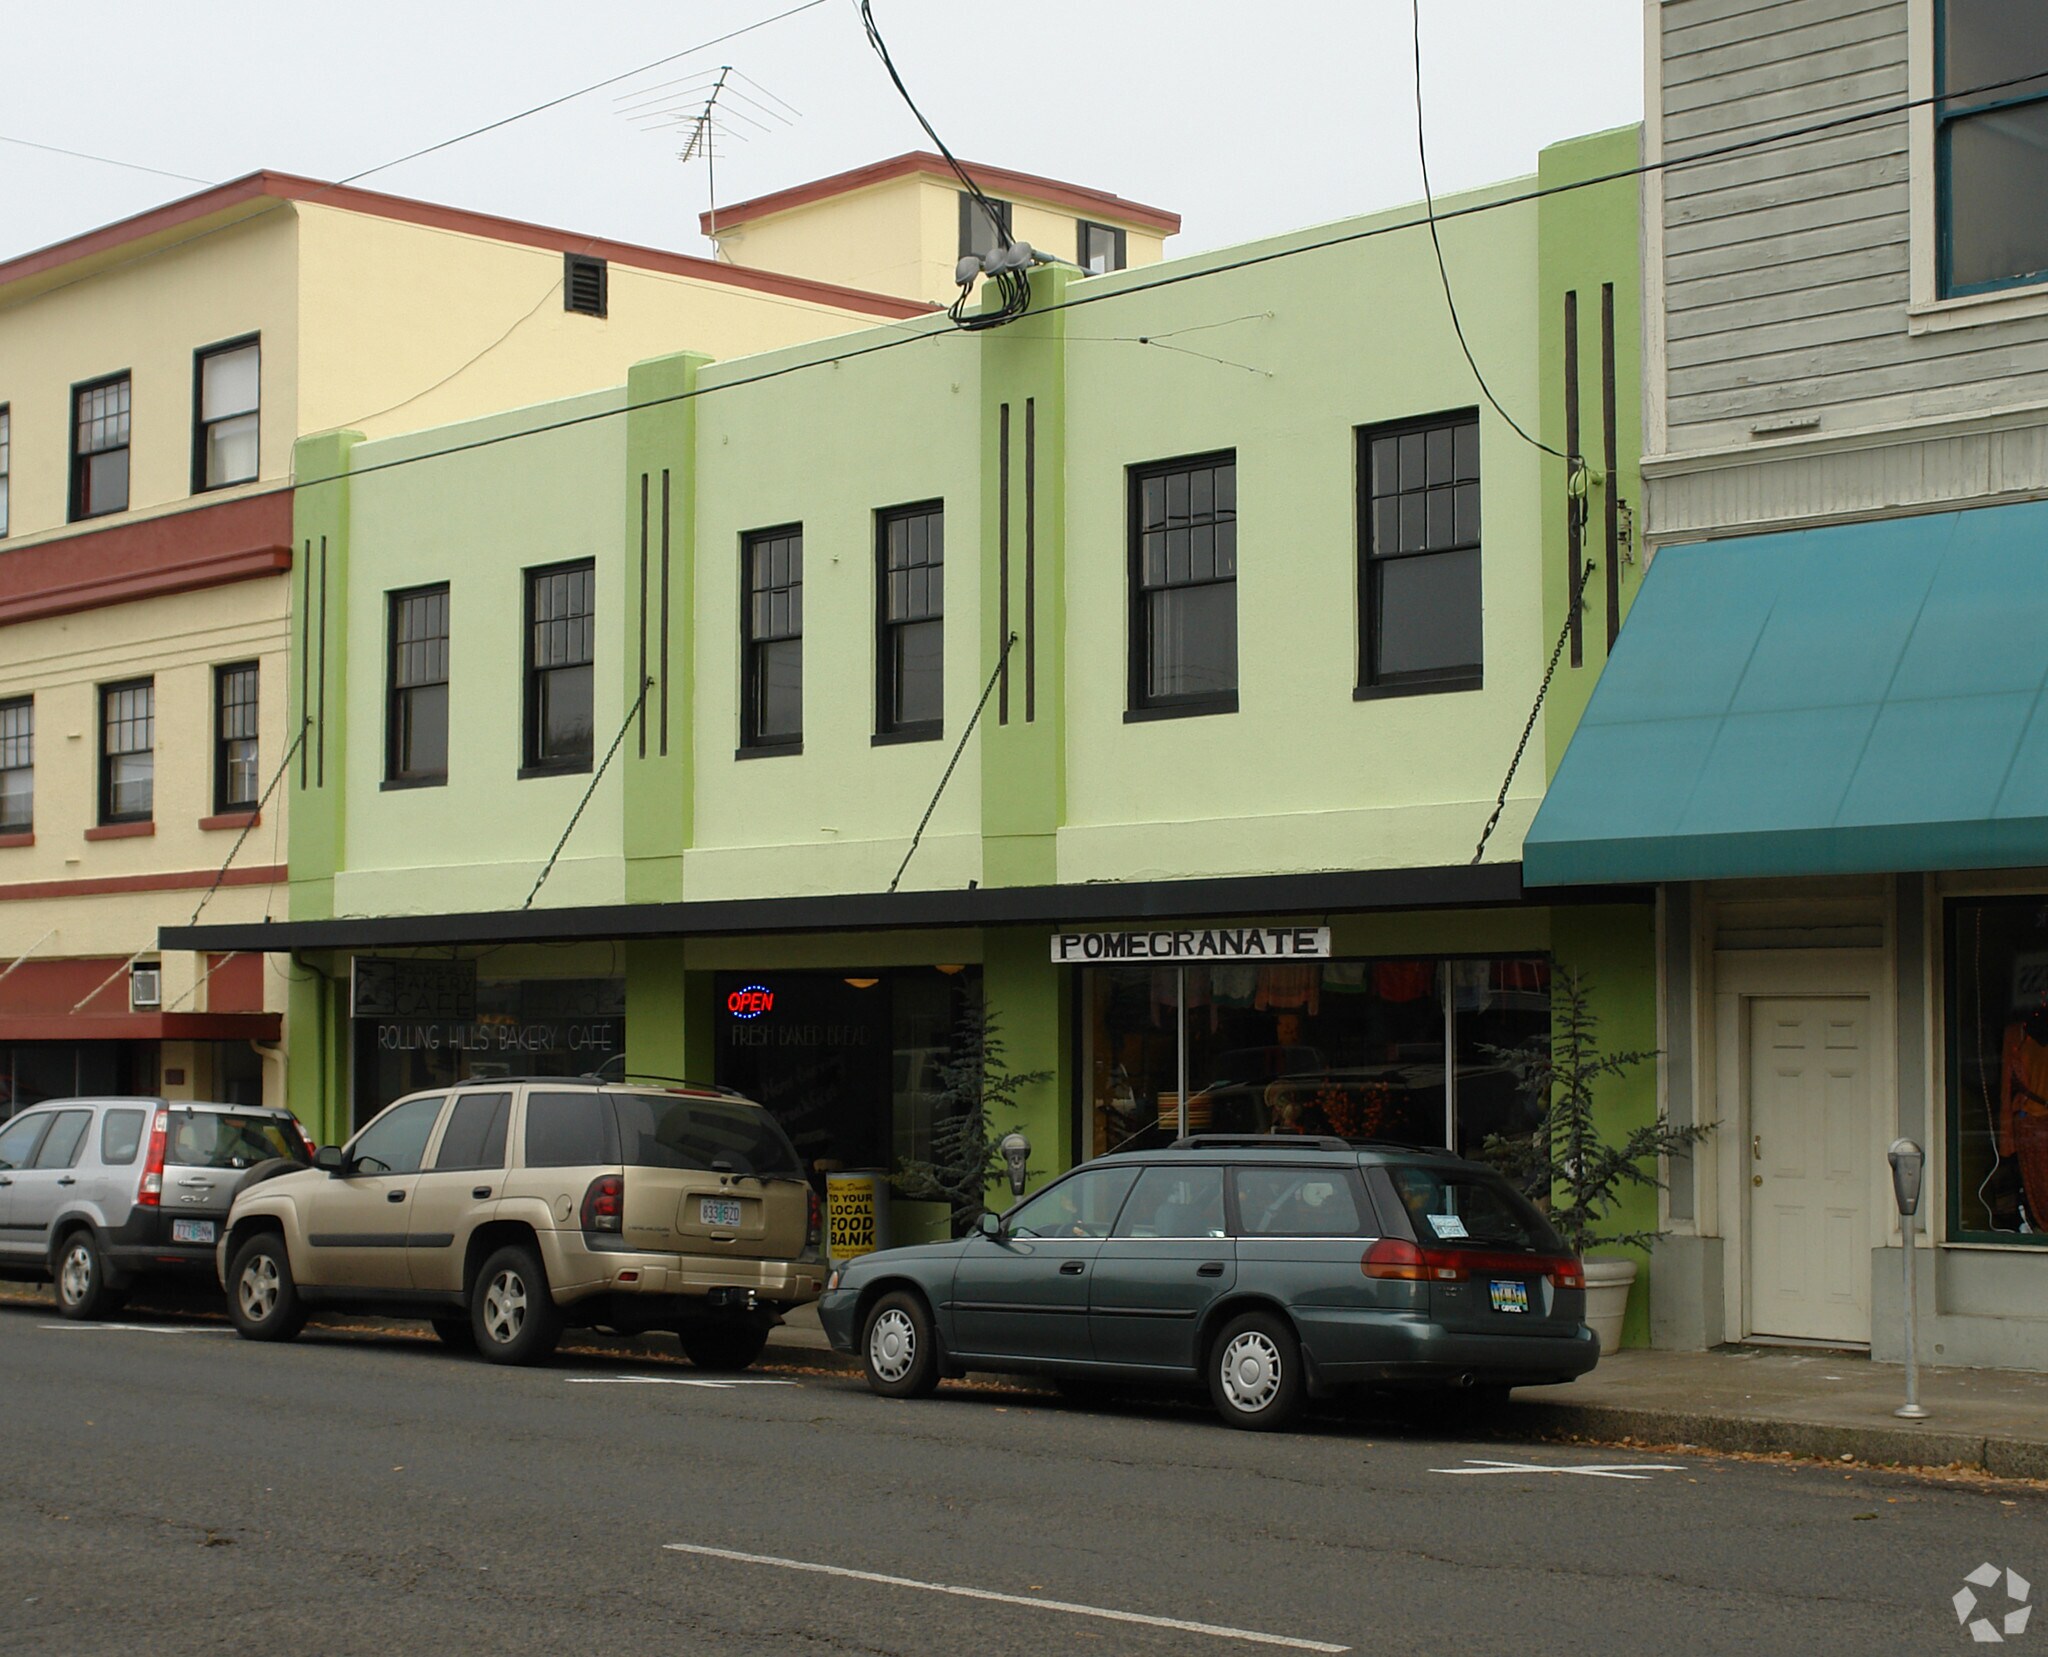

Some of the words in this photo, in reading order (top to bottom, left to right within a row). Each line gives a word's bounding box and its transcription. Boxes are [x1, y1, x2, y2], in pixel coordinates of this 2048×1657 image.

[1059, 928, 1319, 959] POMEGRANATE
[397, 975, 472, 992] BAKERY
[727, 991, 775, 1012] OPEN
[378, 1025, 440, 1051] ROLLING
[448, 1025, 490, 1051] HILLS
[499, 1025, 559, 1051] BAKERY
[567, 1022, 612, 1051] CAFÉ
[732, 1024, 774, 1046] FRESH
[779, 1024, 824, 1046] BAKED
[827, 1024, 872, 1046] BREAD
[829, 1194, 839, 1203] TO
[842, 1193, 873, 1203] YOUR
[703, 1205, 719, 1219] 833
[830, 1204, 872, 1215] LOCAL
[830, 1217, 874, 1231] FOOD
[830, 1231, 875, 1246] BANK
